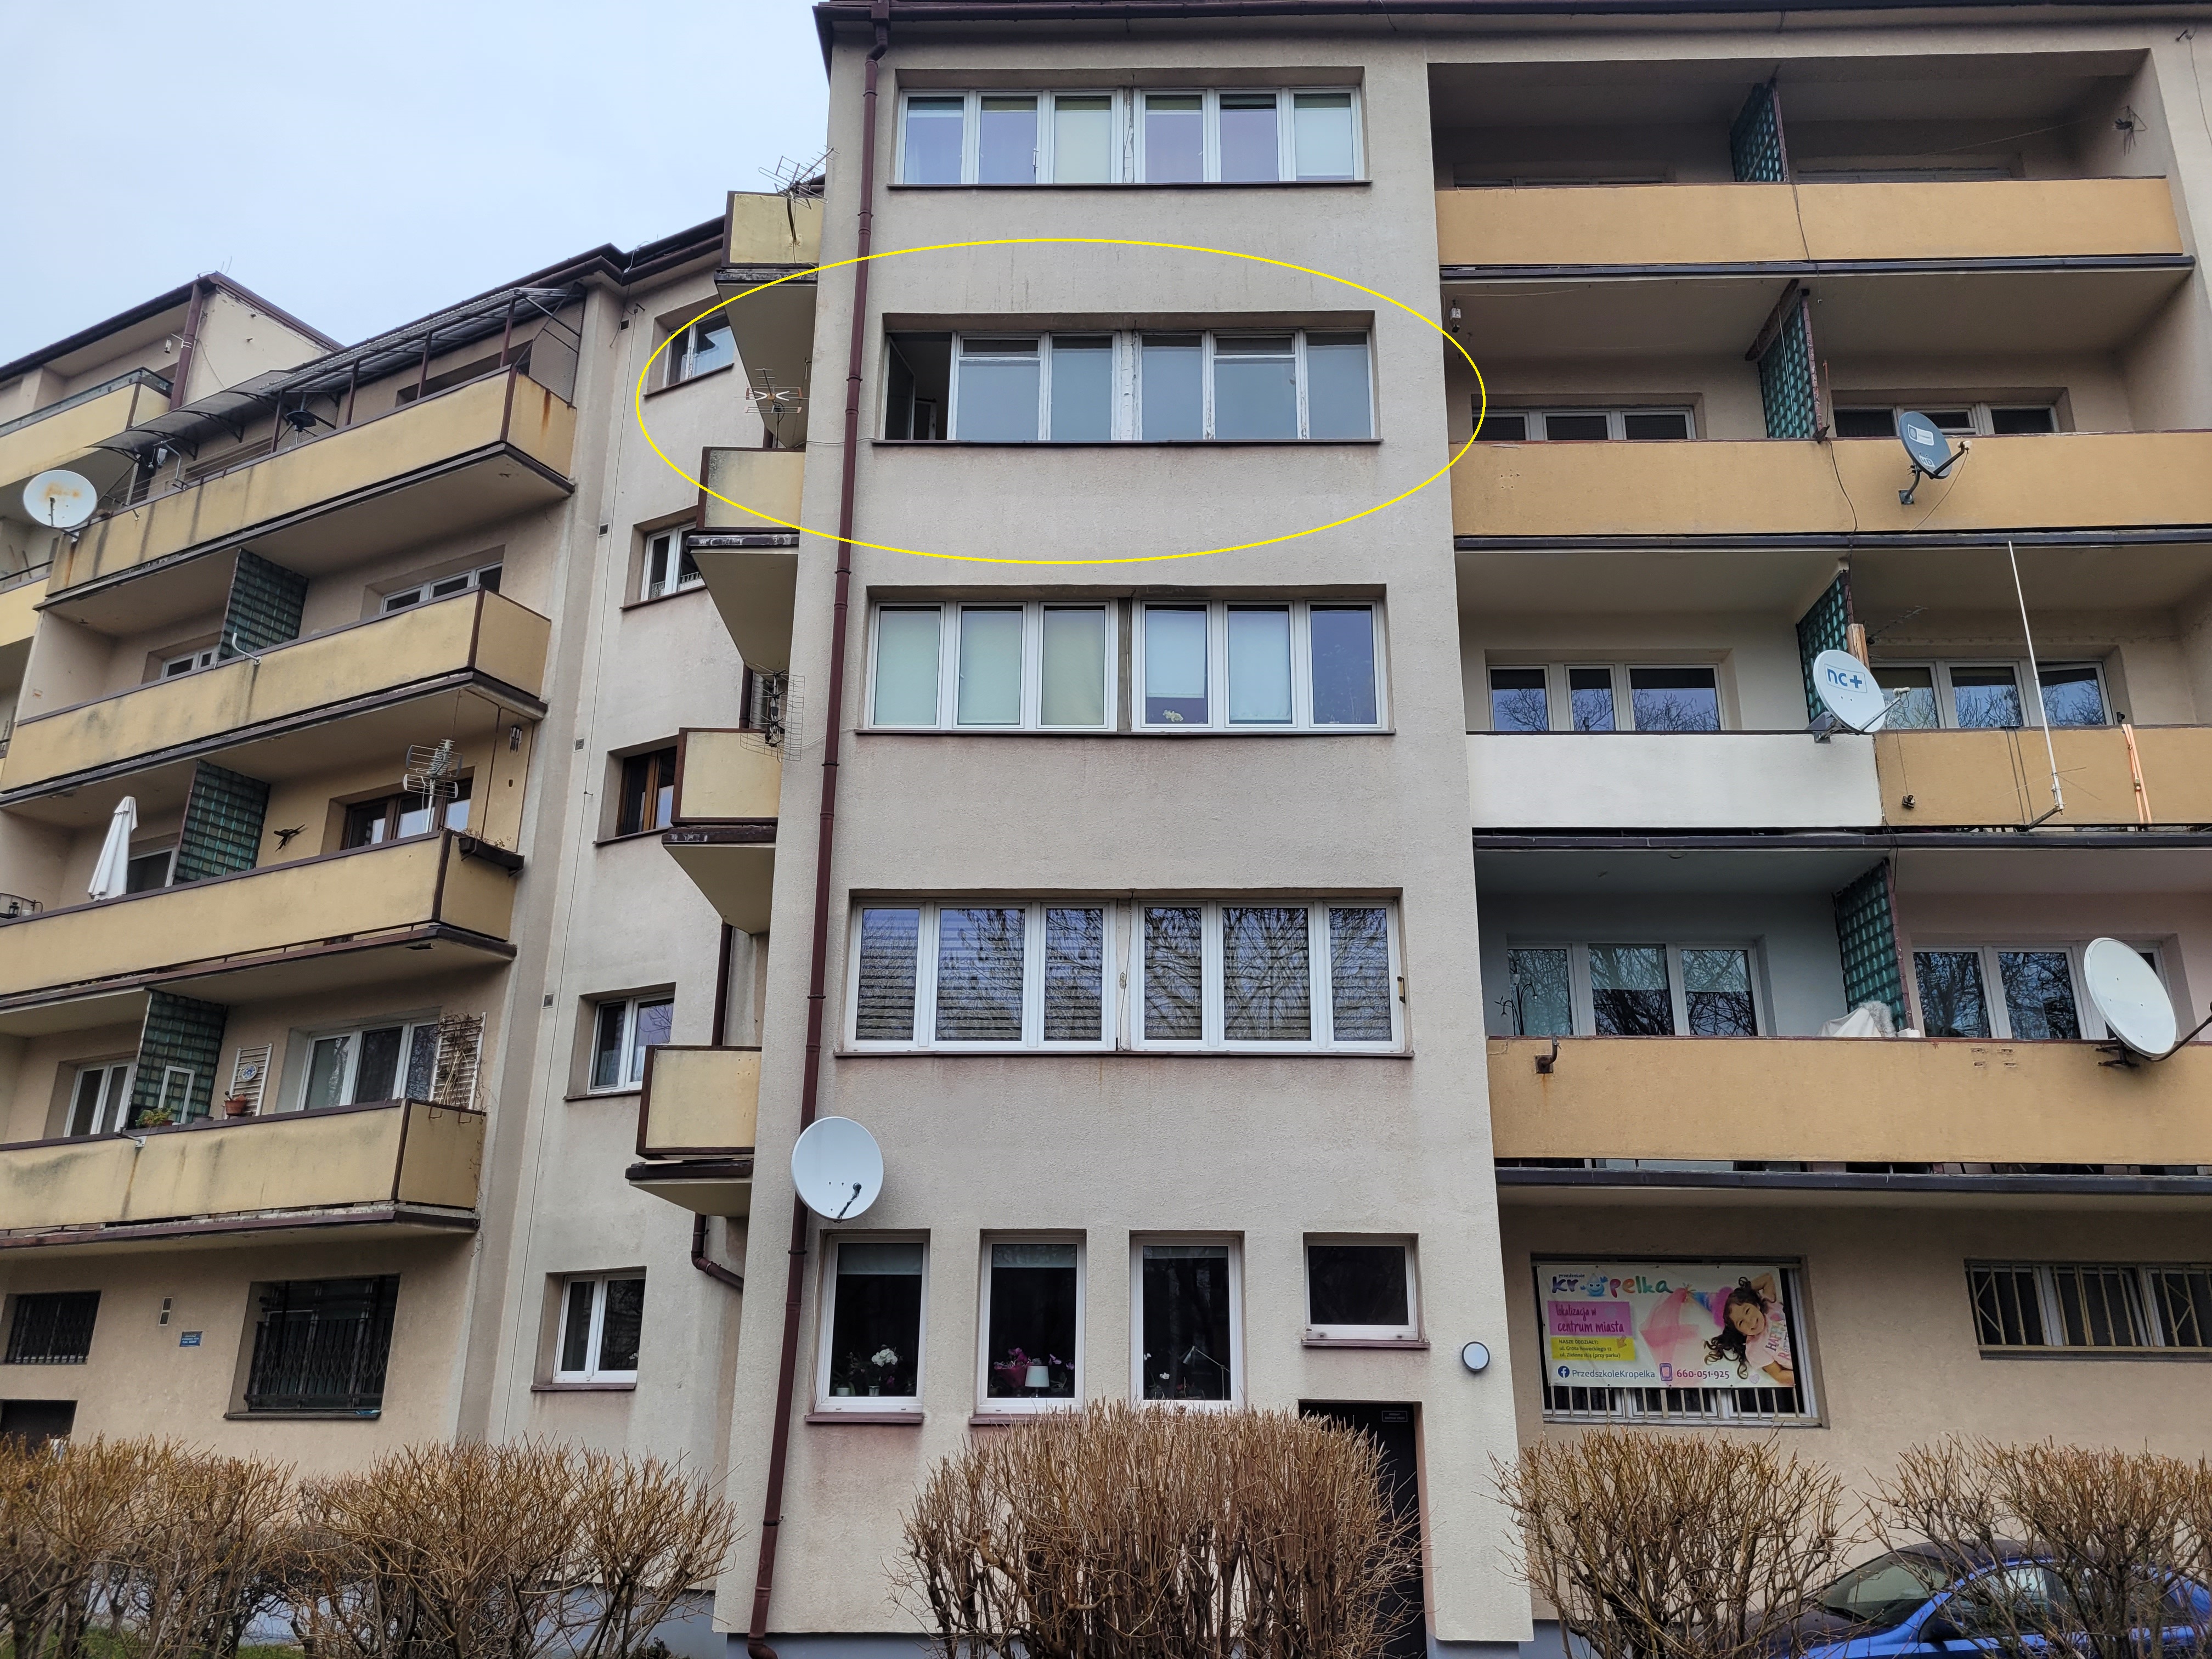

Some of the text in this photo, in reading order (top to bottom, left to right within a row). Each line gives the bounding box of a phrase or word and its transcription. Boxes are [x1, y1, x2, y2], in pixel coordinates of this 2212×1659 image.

[1920, 457, 1933, 466] HD
[1826, 668, 1863, 689] nc+
[1551, 1276, 1674, 1298] krpelka
[1555, 1304, 1597, 1322] lokalizacja w
[1558, 1320, 1624, 1333] centrum miasta
[1572, 1369, 1656, 1380] PrzedszkoleKropelka
[1677, 1369, 1730, 1379] 660-051-925
